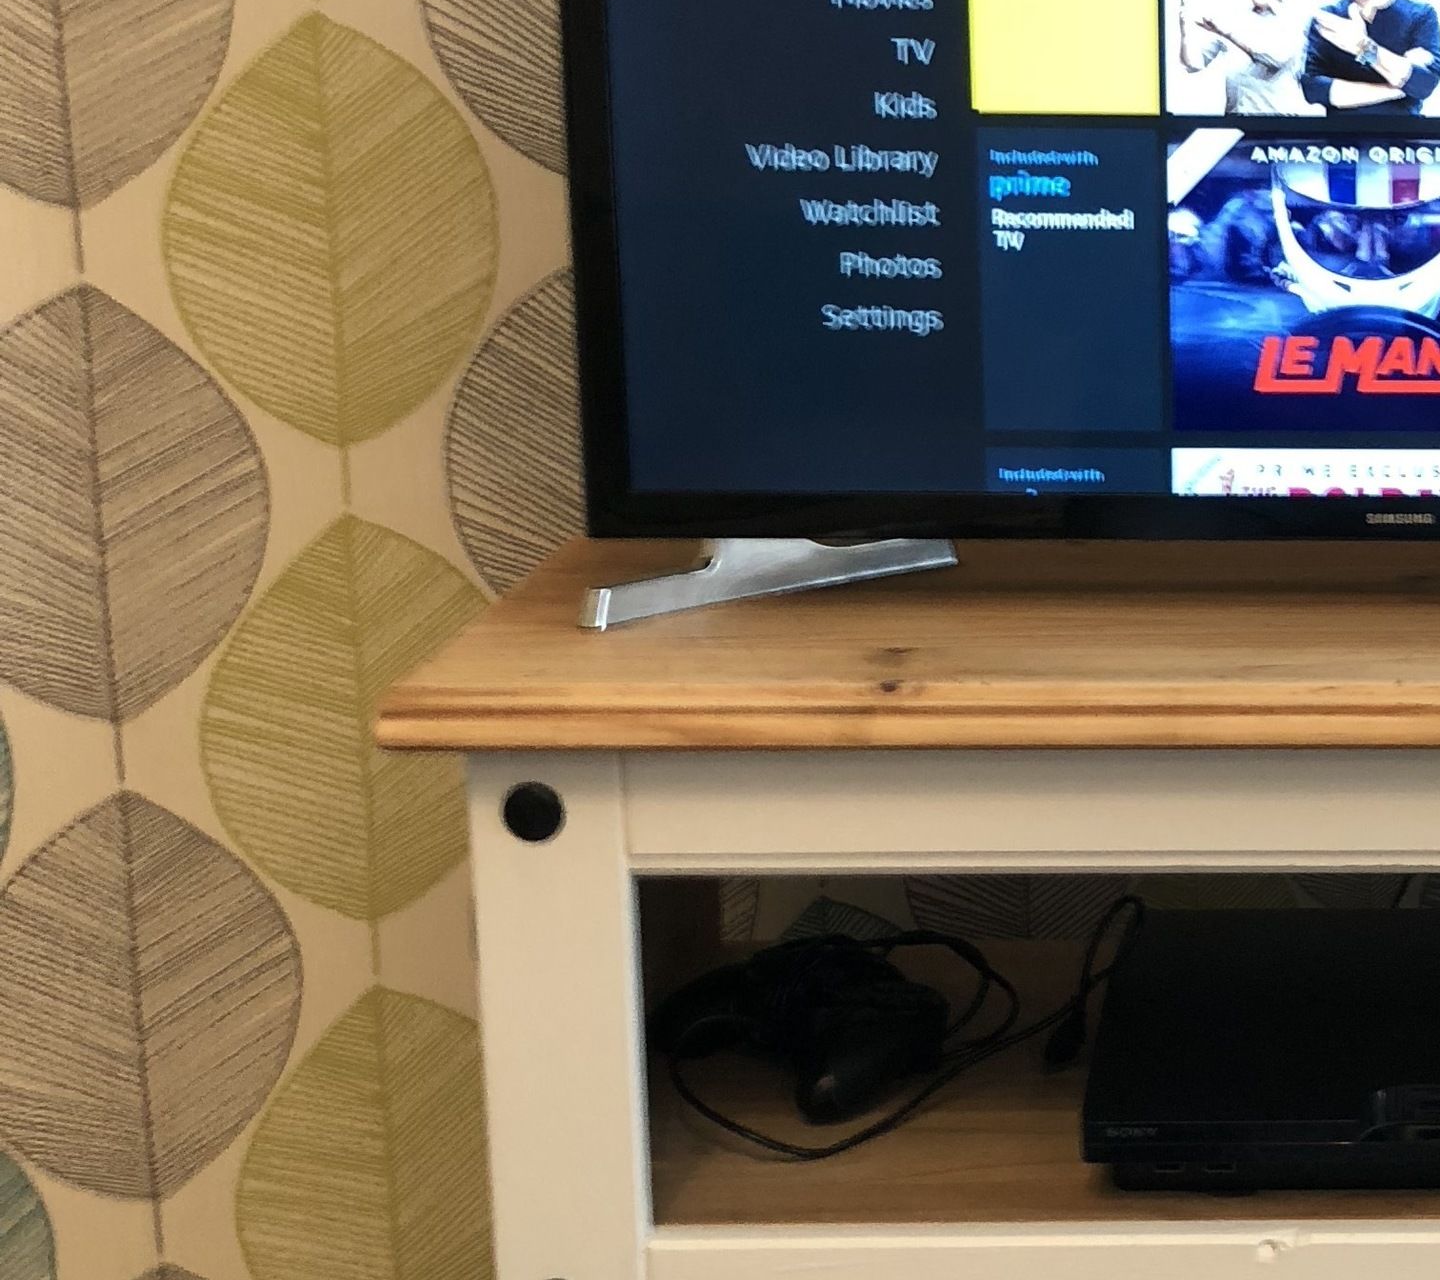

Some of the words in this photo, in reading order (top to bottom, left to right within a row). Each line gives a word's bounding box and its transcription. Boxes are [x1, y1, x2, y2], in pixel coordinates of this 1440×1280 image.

[890, 38, 936, 65] TV
[874, 91, 938, 119] Kids
[745, 144, 830, 170] Video
[835, 144, 939, 178] Library
[1251, 146, 1359, 164] AMAZON
[989, 169, 1071, 202] prime
[800, 199, 941, 226] Watchlist
[991, 207, 1135, 230] Recommended
[992, 229, 1025, 251] TV
[840, 252, 943, 279] Photos
[821, 304, 945, 336] Settings
[1254, 336, 1334, 393] LE
[1256, 464, 1330, 477] PRME
[1366, 513, 1437, 525] SAMSUNG
